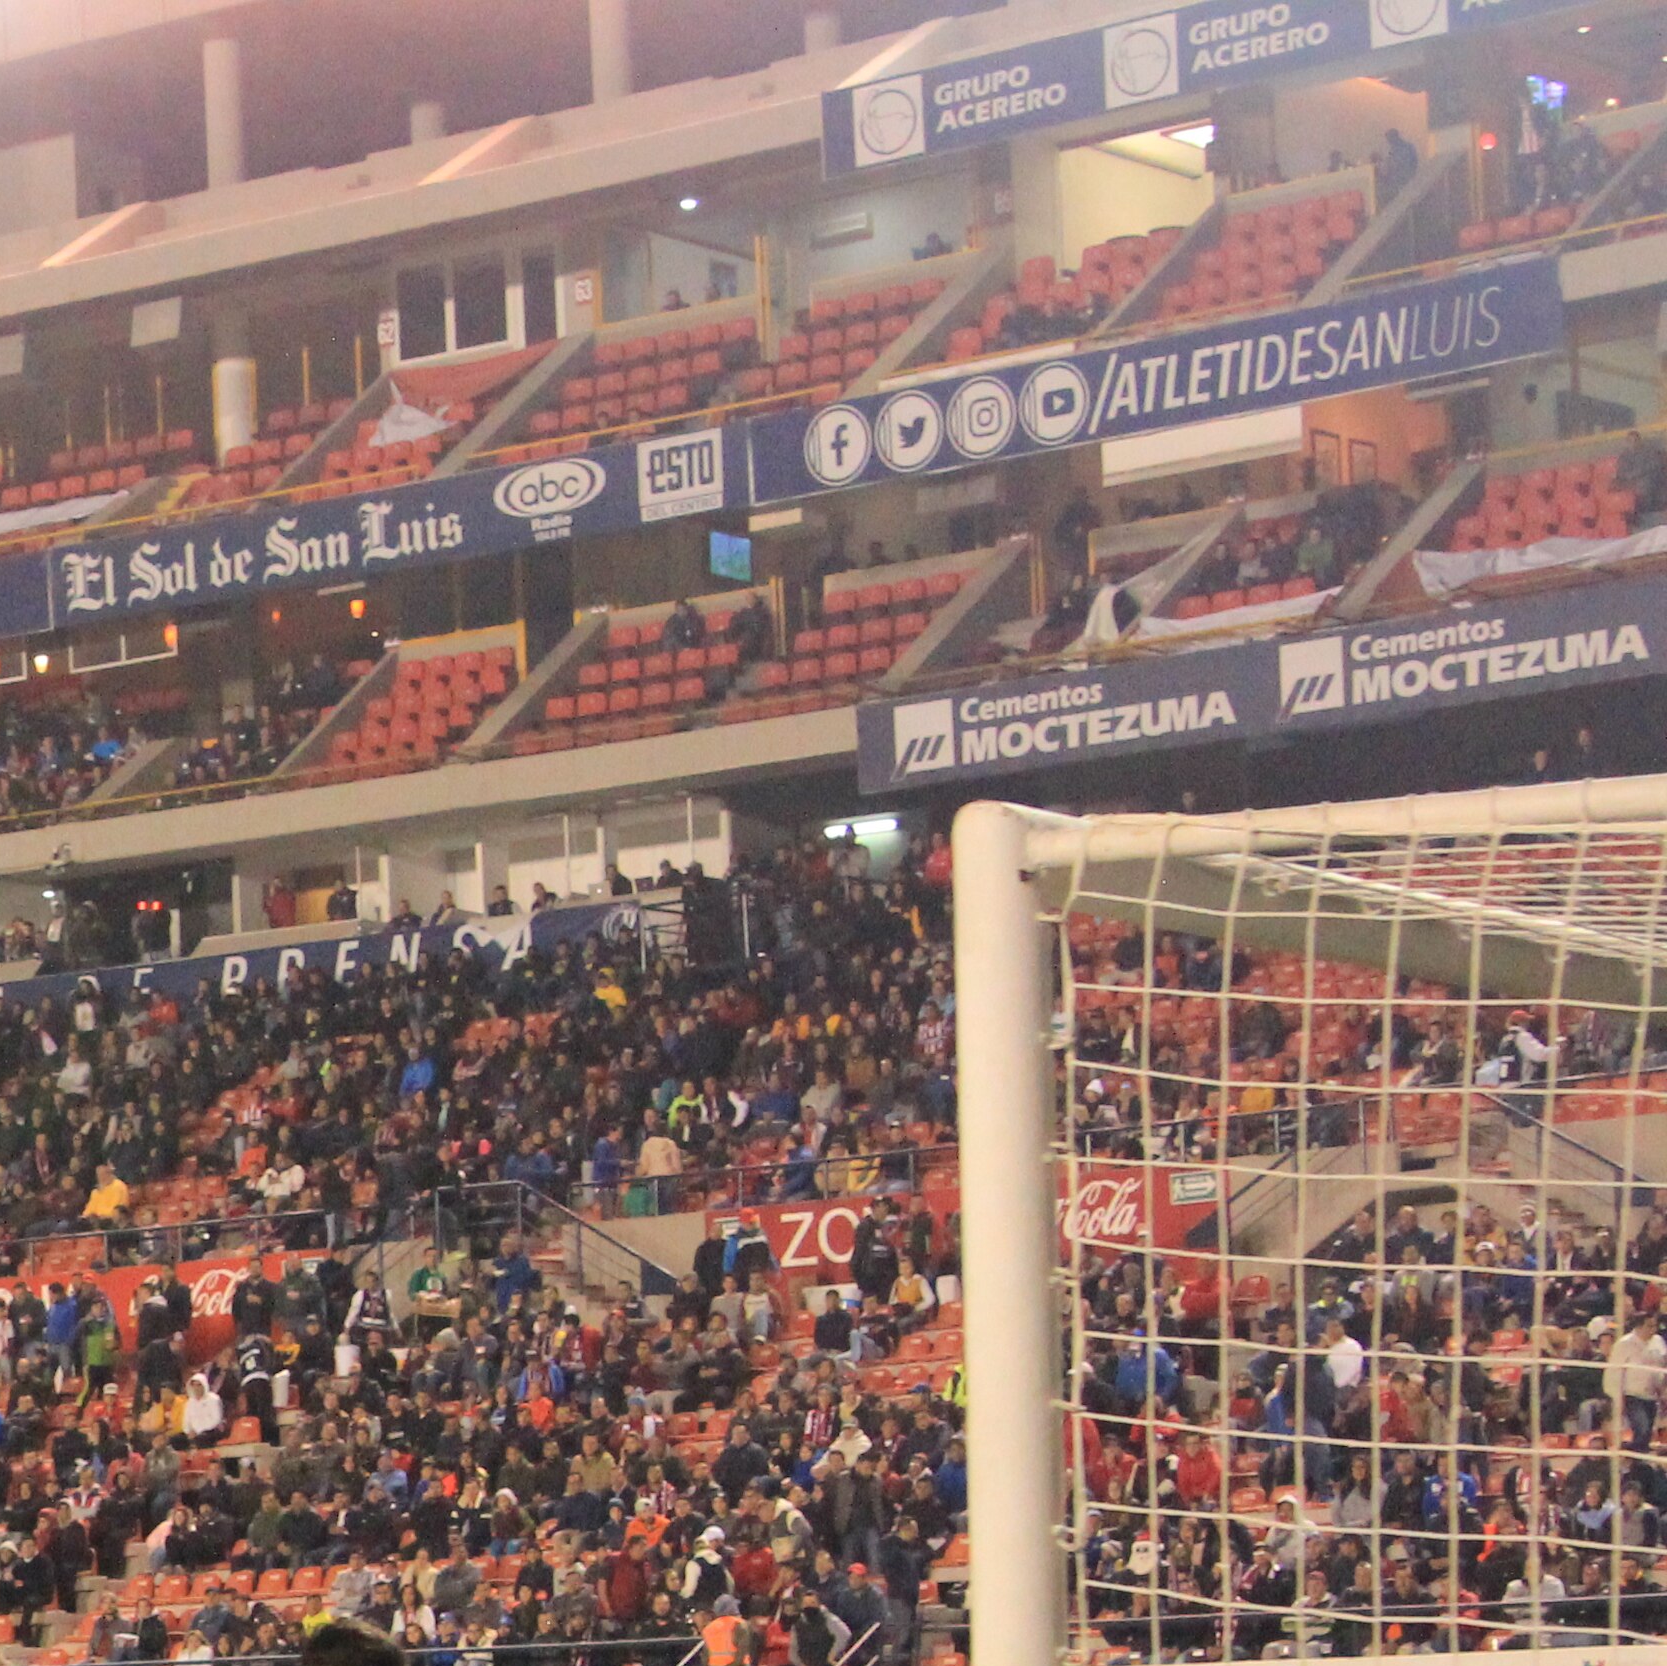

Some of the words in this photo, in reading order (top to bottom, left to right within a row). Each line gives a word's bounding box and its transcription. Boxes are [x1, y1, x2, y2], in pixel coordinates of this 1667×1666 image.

[1189, 3, 1289, 46] GRUPO
[1190, 21, 1330, 74] ACERERO
[933, 66, 1031, 108] GRUPO
[936, 83, 1067, 134] ACERERO
[520, 473, 581, 506] abc
[61, 544, 117, 613] El
[126, 541, 197, 608] Sol
[207, 528, 254, 589] de
[263, 518, 351, 578] San
[360, 499, 465, 561] Luis
[1351, 616, 1505, 661] Cementos
[1352, 624, 1649, 706] MOCTEZUMA
[959, 682, 1103, 725] Cementos
[960, 690, 1236, 766] MOCTEZUMA
